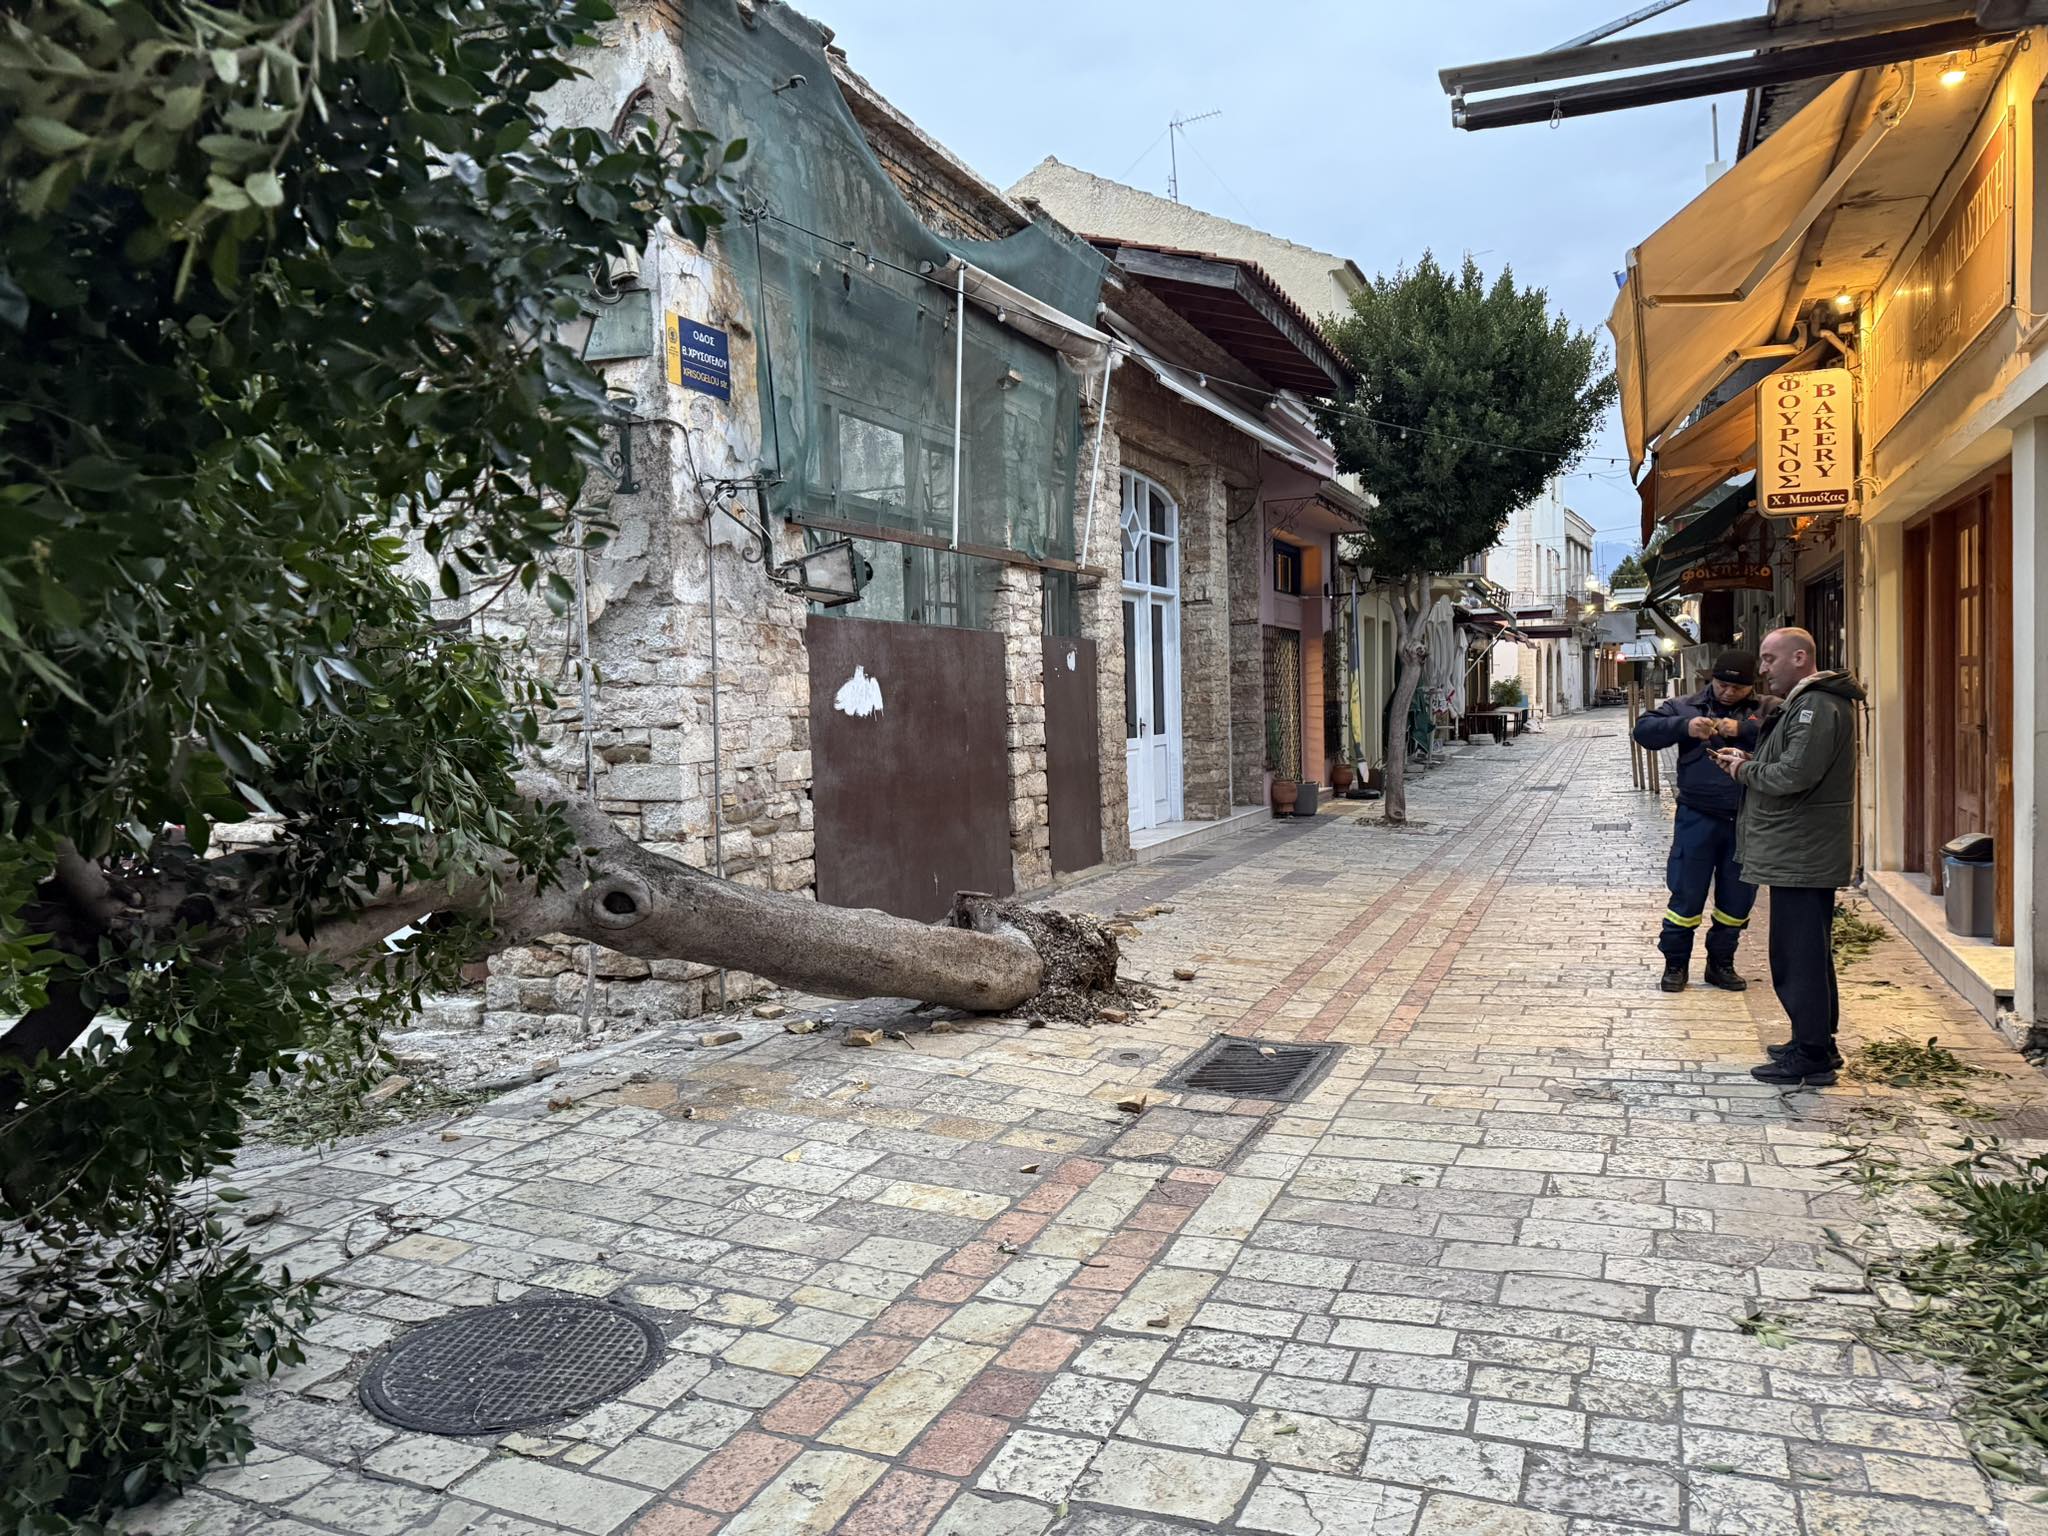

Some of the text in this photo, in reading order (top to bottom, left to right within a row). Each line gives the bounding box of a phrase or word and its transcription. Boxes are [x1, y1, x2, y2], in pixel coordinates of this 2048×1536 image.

[693, 330, 715, 346] ΟΔΟΣ
[1778, 378, 1801, 489] ΦΟΥΡΝΟΣ
[1813, 383, 1837, 478] BAKERY
[1771, 491, 1845, 506] Χ. Μπούζας
